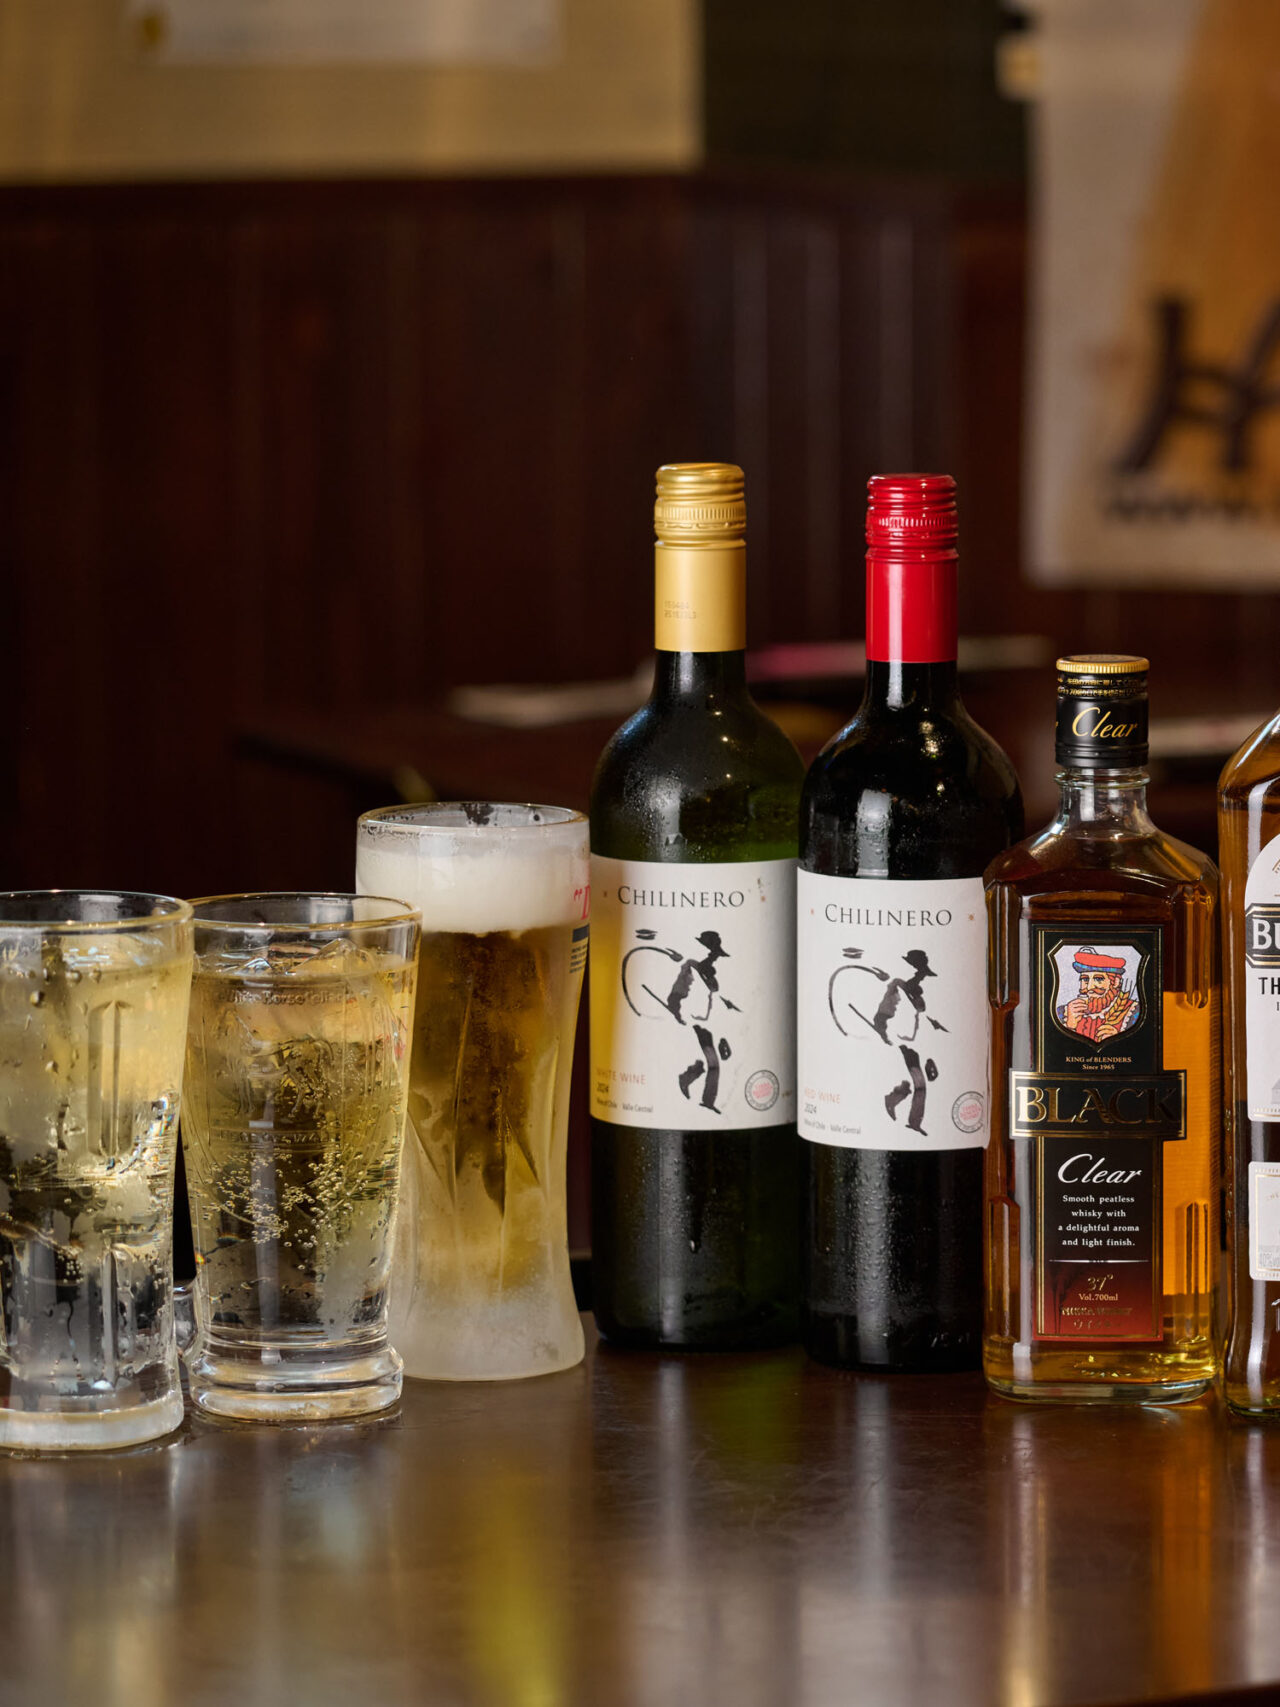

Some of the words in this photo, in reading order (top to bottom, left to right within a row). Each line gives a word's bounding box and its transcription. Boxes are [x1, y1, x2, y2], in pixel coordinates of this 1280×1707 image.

[1072, 706, 1138, 739] Clear
[617, 885, 745, 908] CHILINERO
[824, 904, 952, 926] CHILINERO
[620, 1072, 647, 1085] WINE
[1016, 1086, 1182, 1124] BLACK
[1057, 1153, 1142, 1184] Clear
[1062, 1194, 1095, 1203] Smooth
[1099, 1195, 1135, 1205] peatless
[1071, 1209, 1103, 1219] whisky
[1106, 1209, 1127, 1217] with
[1066, 1223, 1110, 1234] delightful
[1062, 1238, 1078, 1246] and
[1082, 1238, 1103, 1248] light
[1106, 1237, 1136, 1246] finish.
